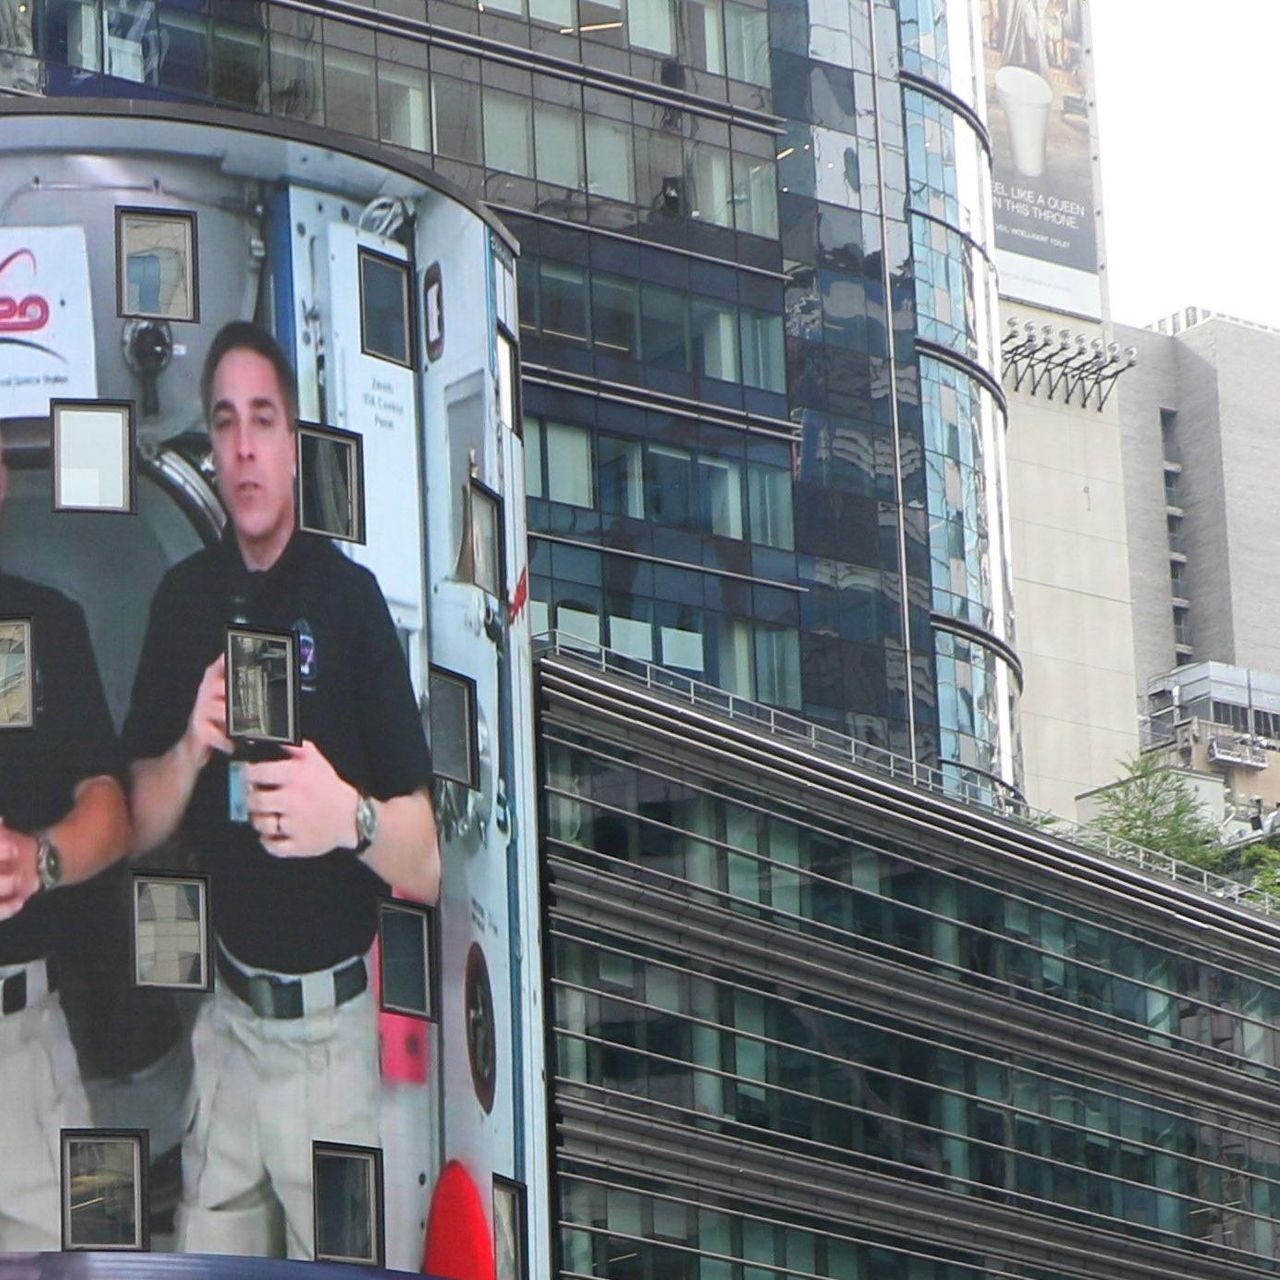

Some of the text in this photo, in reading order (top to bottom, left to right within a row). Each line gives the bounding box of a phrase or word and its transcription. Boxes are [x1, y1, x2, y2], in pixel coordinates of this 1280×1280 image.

[1006, 199, 1030, 217] THIS
[1011, 187, 1034, 204] LIKE
[1037, 194, 1045, 206] A
[1048, 196, 1085, 216] QUEEN
